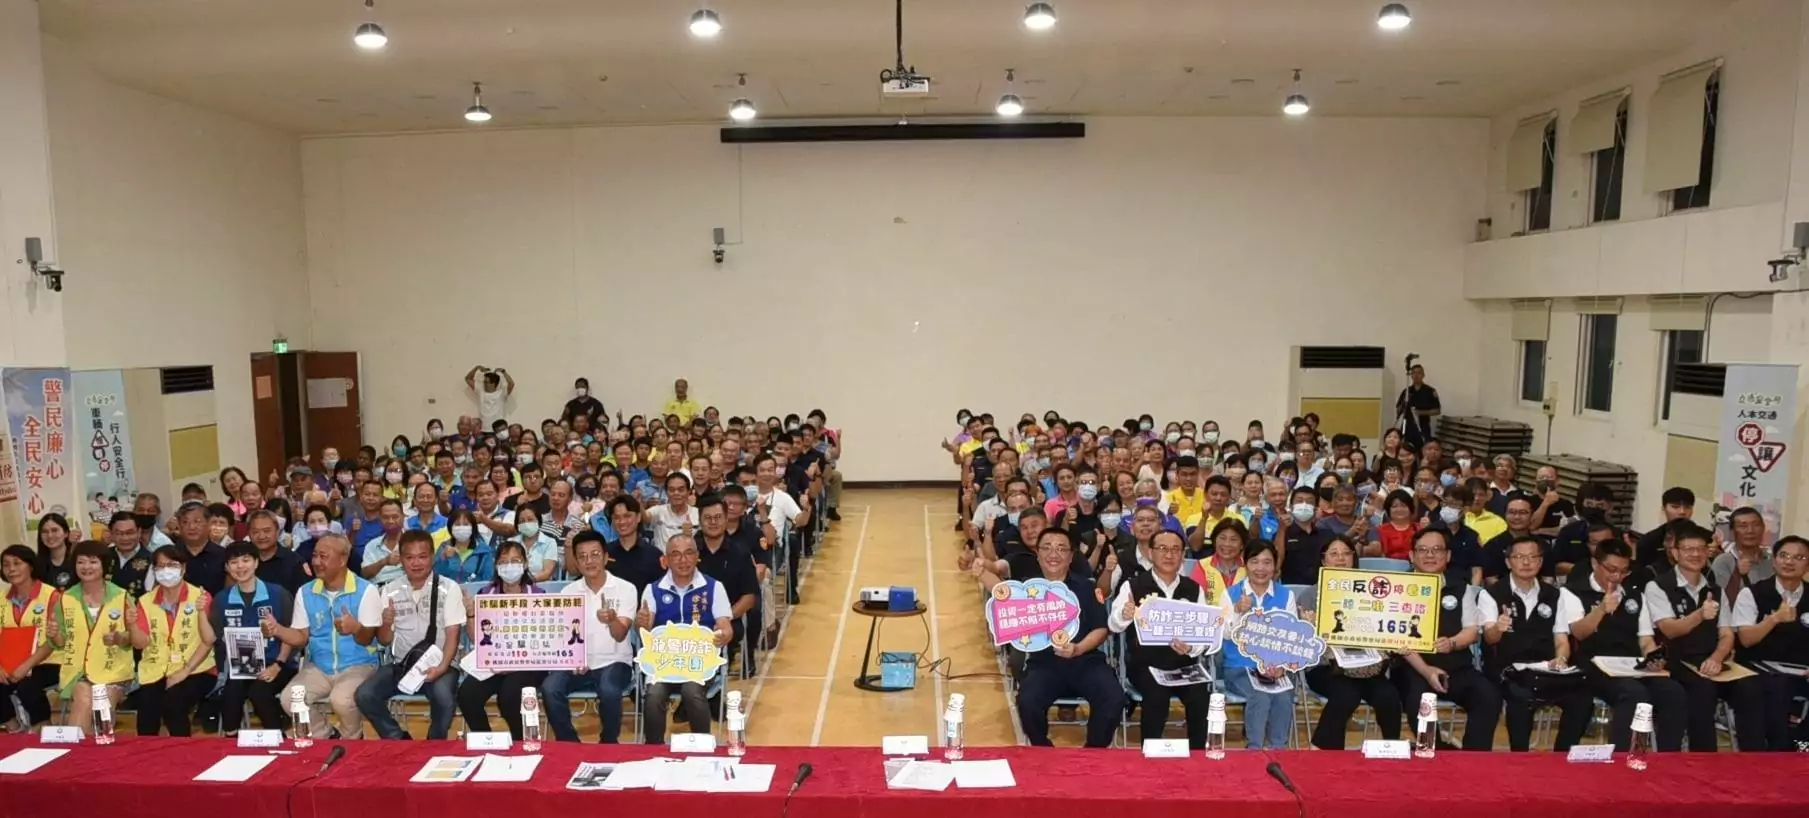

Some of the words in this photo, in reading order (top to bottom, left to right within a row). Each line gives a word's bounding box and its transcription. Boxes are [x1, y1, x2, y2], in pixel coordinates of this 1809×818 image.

[1737, 409, 1777, 420] 人本交通
[44, 379, 64, 480] 警民廉心
[110, 422, 125, 479] 行人安全行
[24, 416, 45, 515] 全民安心
[1739, 464, 1758, 497] 文化
[998, 600, 1067, 618] 投資一定有風險
[1148, 608, 1209, 624] 防詐三步驟
[1376, 619, 1408, 634] 165
[556, 649, 574, 657] 165
